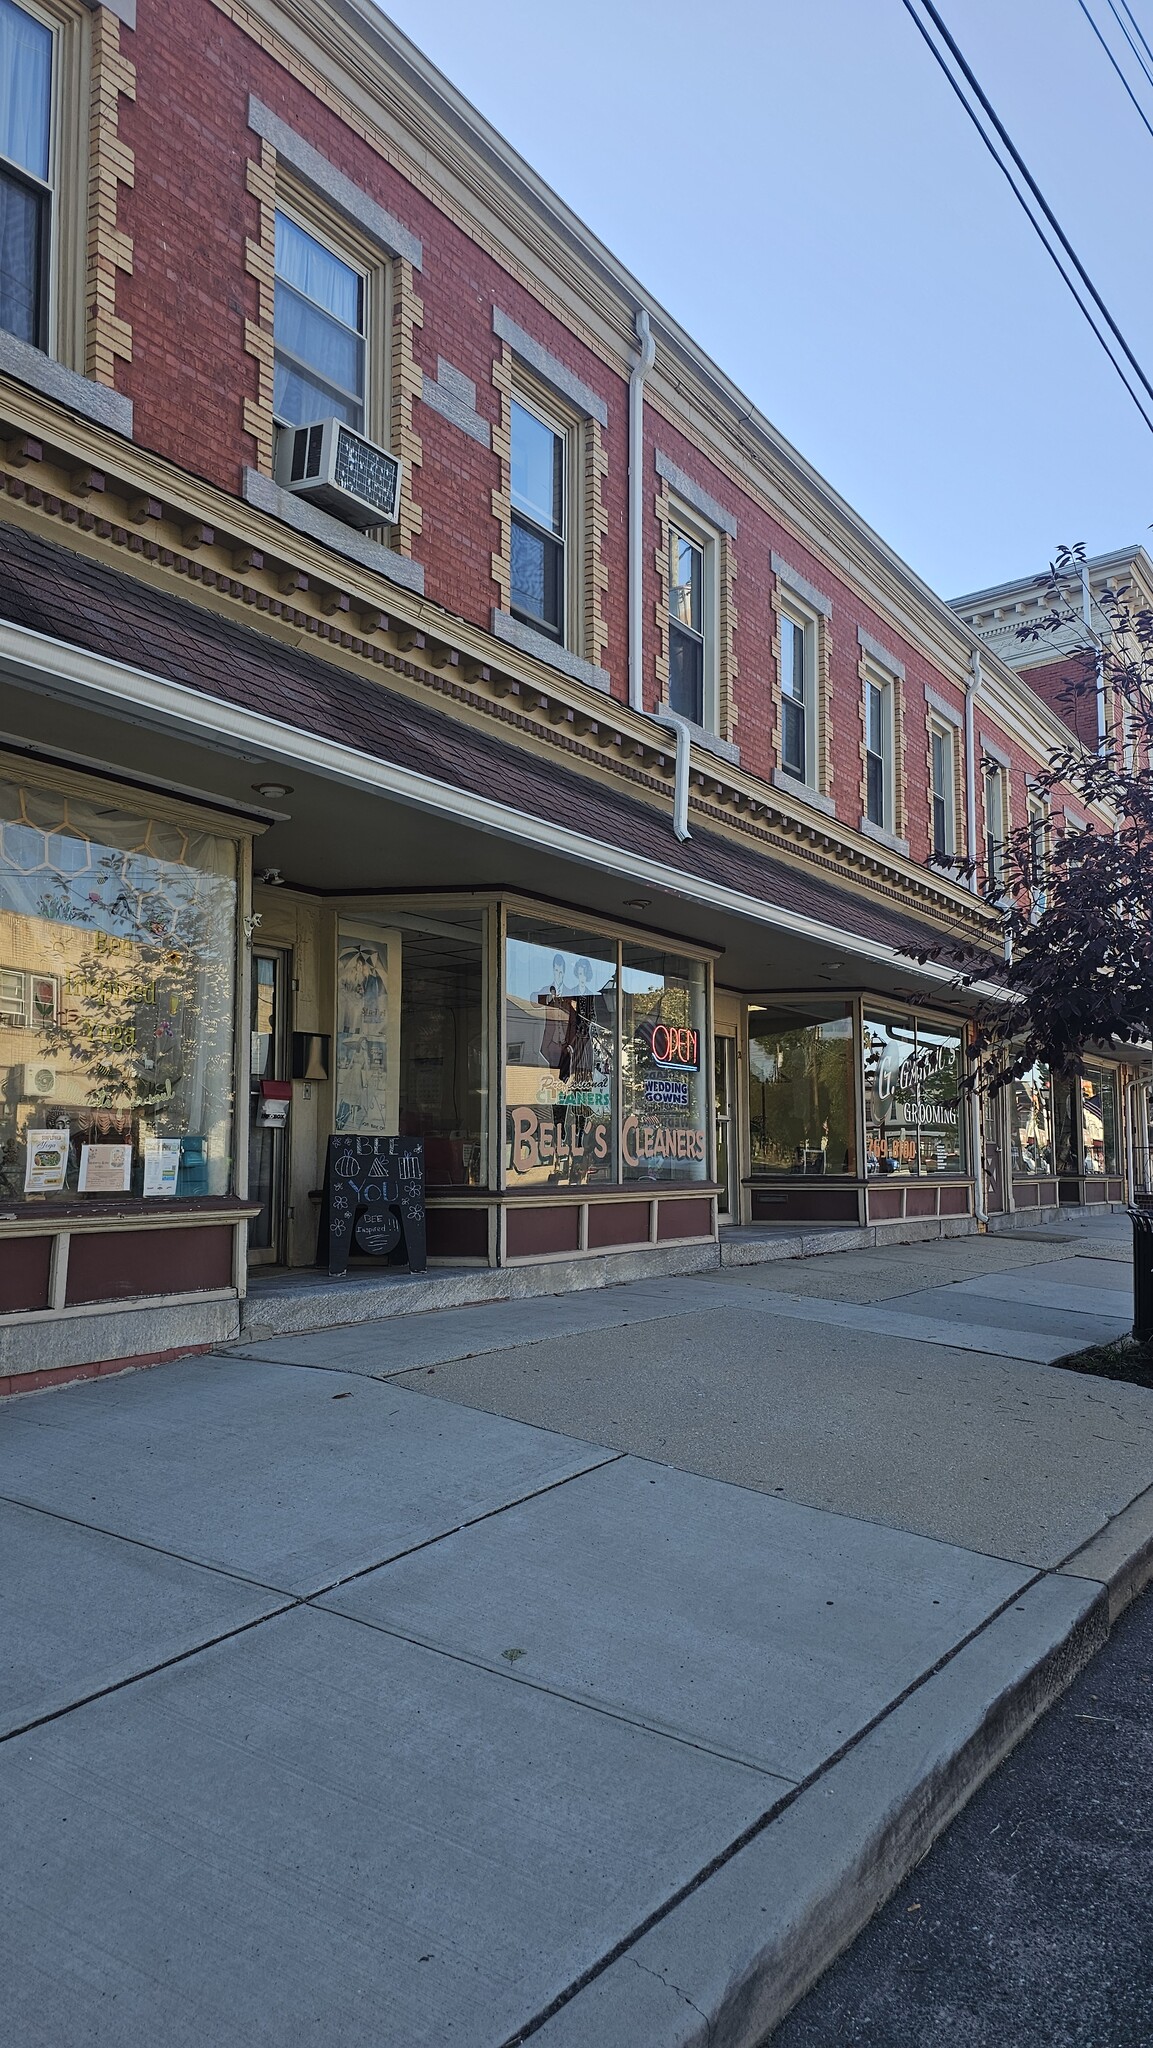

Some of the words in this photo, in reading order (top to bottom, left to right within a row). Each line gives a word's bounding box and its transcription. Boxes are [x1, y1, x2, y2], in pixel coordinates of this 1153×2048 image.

[81, 1018, 137, 1053] Yoga
[652, 1024, 697, 1065] OPEN
[541, 1074, 609, 1092] Professional
[645, 1080, 688, 1095] WEDDING
[536, 1090, 609, 1106] CLEANERS
[645, 1092, 688, 1105] GOWNS
[904, 1102, 957, 1125] GROOMING
[356, 1136, 399, 1156] BEE
[512, 1106, 606, 1173] BELL'S
[622, 1115, 704, 1168] CLEANERS
[347, 1179, 400, 1203] YOU
[363, 1214, 384, 1223] BEE
[356, 1223, 386, 1235] Inspired
